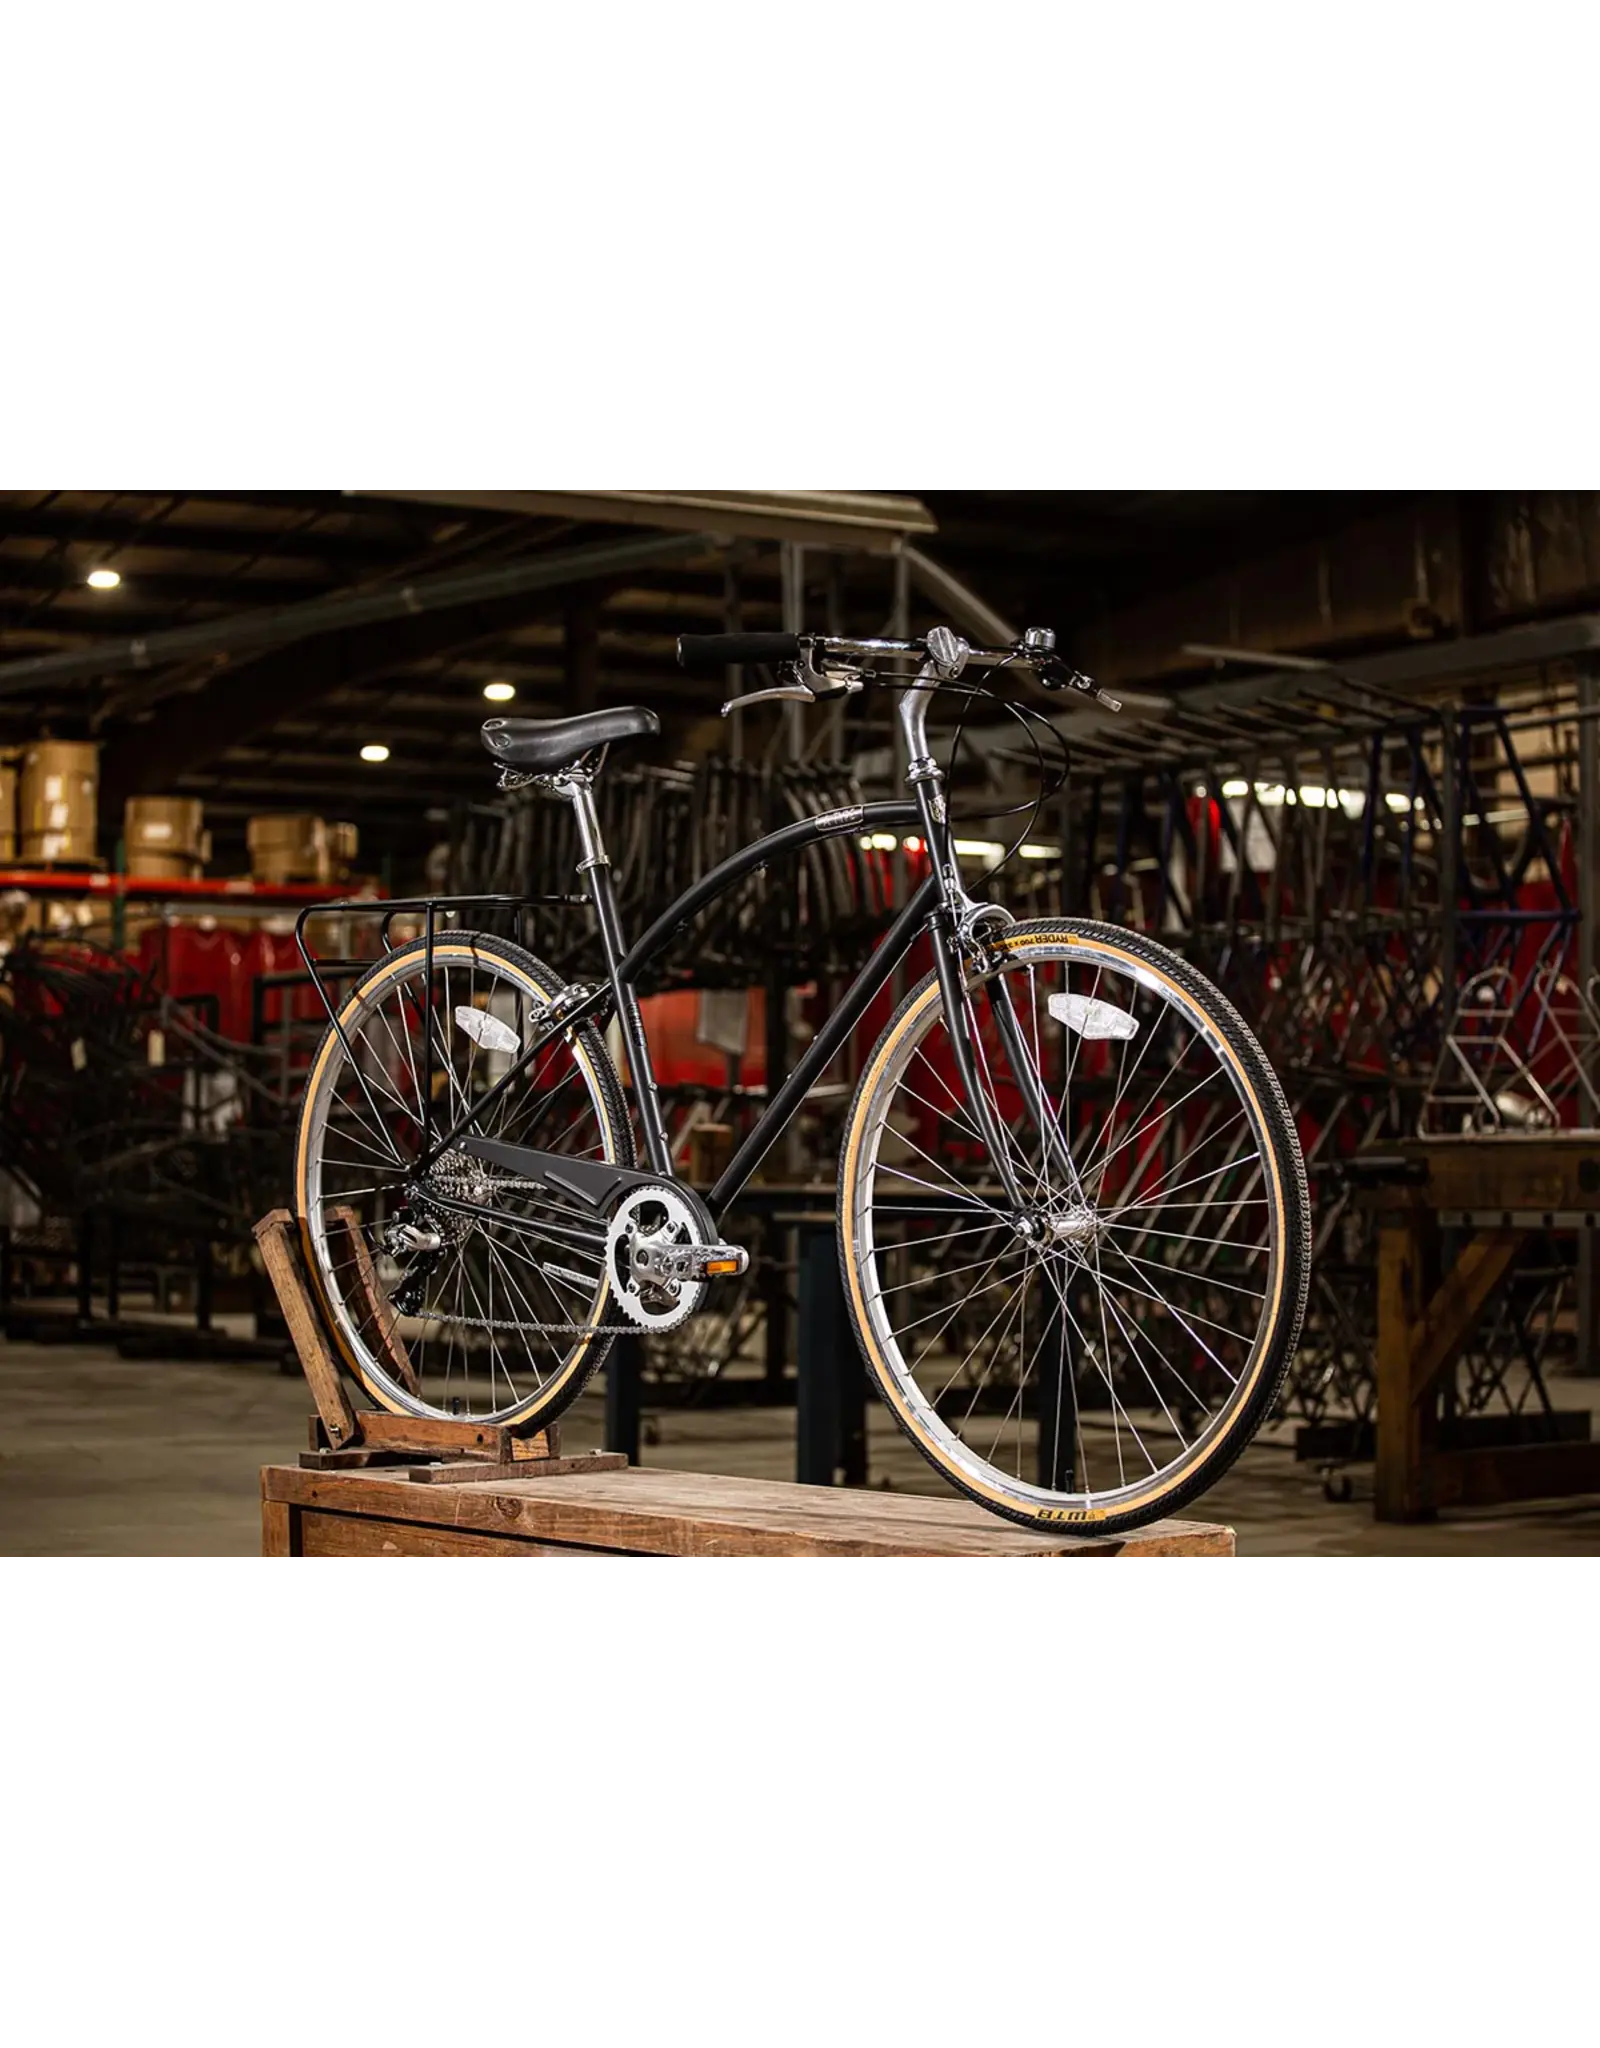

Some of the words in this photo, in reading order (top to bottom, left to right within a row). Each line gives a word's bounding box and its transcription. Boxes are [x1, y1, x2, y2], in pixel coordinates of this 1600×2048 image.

[1020, 938, 1034, 946] 700
[1035, 933, 1069, 944] RYDER
[1037, 1509, 1087, 1521] WTB
